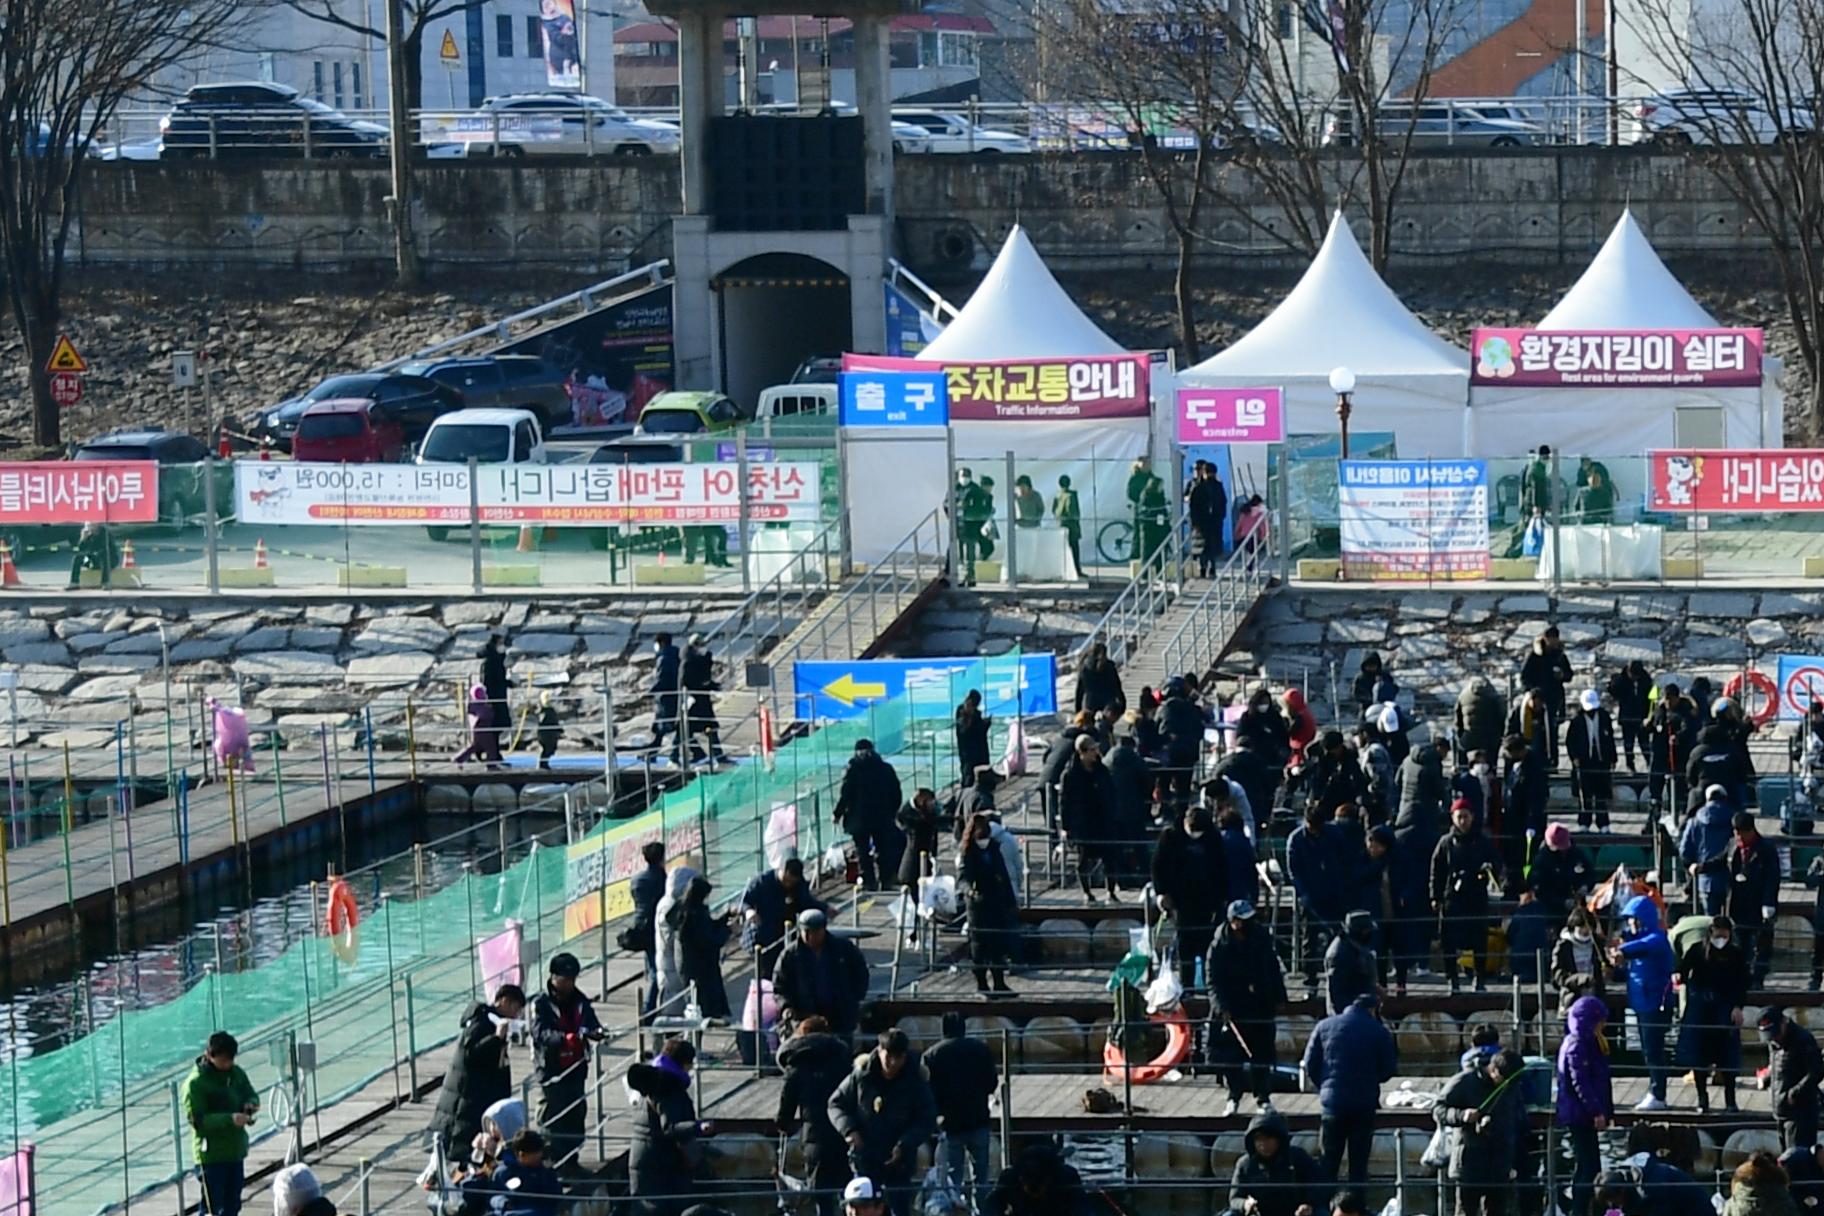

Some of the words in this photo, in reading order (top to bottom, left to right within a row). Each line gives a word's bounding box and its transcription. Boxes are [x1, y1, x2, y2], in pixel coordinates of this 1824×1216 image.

[1520, 335, 1674, 371] 환경지킴이
[1683, 335, 1745, 371] 쉼터
[947, 361, 1137, 402] 주차교통안내
[1617, 373, 1672, 383] environment
[887, 411, 907, 421] exit
[994, 404, 1024, 416] Traffic
[1026, 403, 1081, 416] Information
